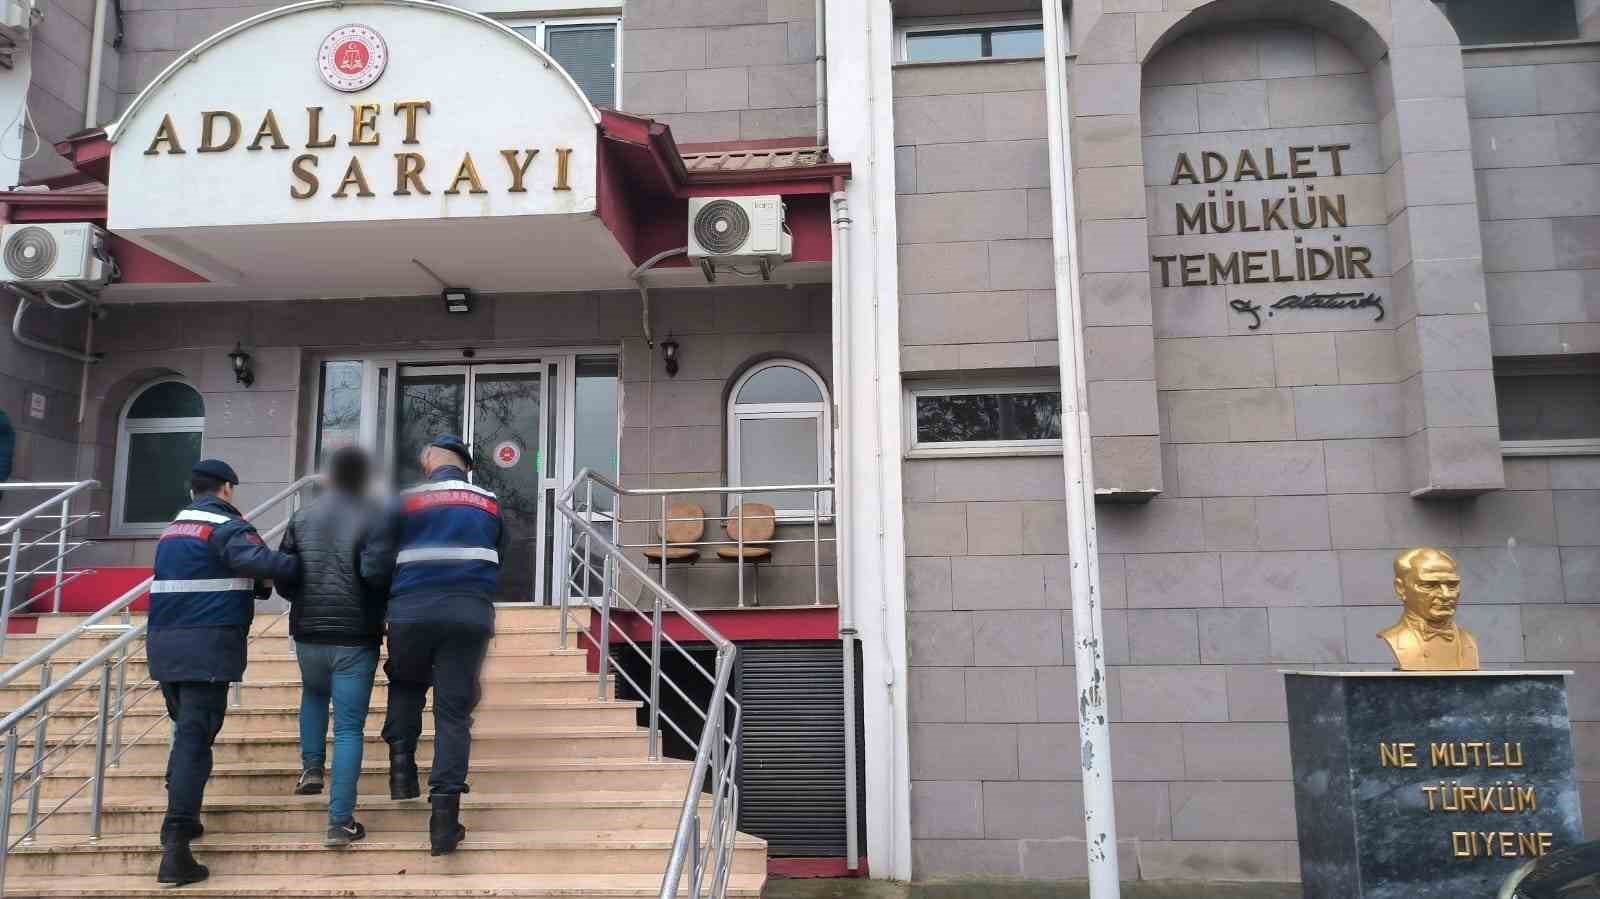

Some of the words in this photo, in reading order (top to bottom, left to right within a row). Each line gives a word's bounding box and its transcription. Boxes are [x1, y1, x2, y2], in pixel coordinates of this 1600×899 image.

[143, 100, 432, 155] ADALET
[290, 148, 574, 200] SARAYI
[1170, 143, 1351, 186] ADALET
[1175, 184, 1348, 236] MÜLKÜN
[1152, 234, 1374, 288] TEMELİDİR
[1379, 742, 1418, 769] NE
[1430, 742, 1525, 769] MUTLU
[1421, 780, 1538, 812] TÜRKÜM
